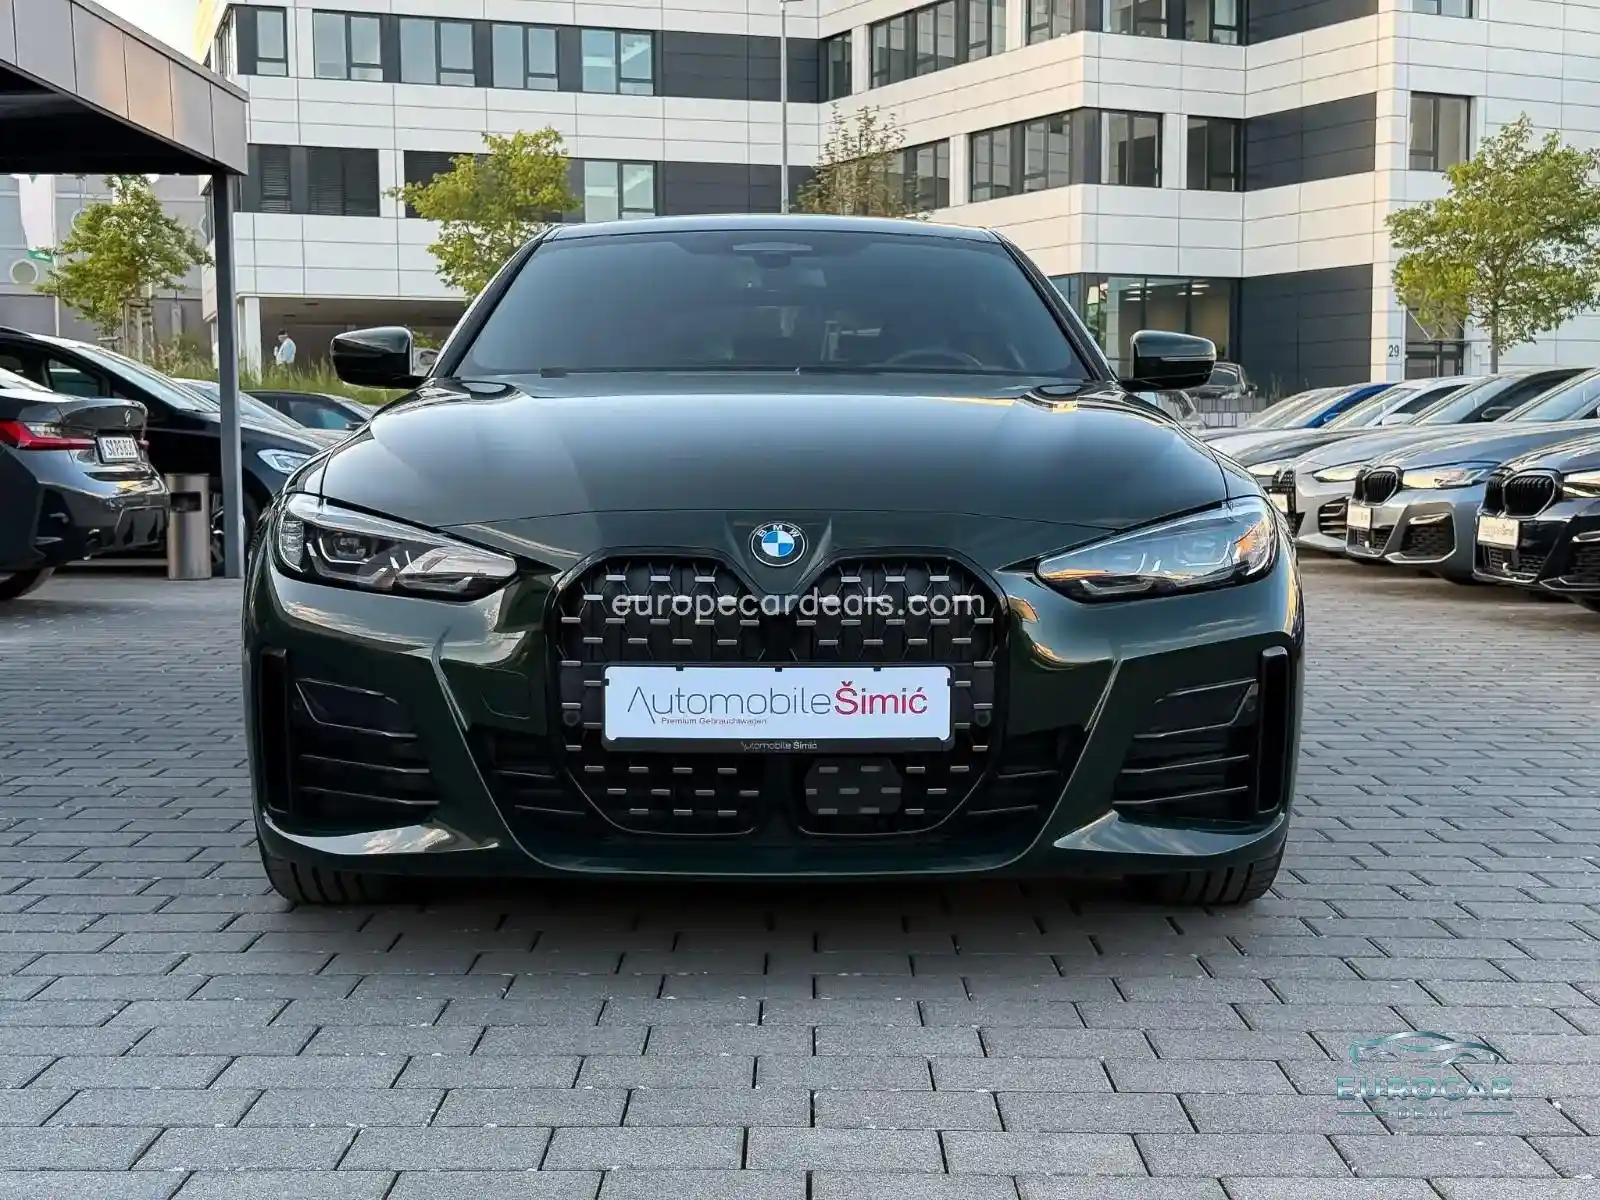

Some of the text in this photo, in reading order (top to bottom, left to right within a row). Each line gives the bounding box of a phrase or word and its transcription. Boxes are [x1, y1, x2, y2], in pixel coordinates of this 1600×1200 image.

[1388, 344, 1400, 357] 29
[756, 524, 801, 538] BMW
[661, 717, 768, 728] Premium Gebrauchtwagen
